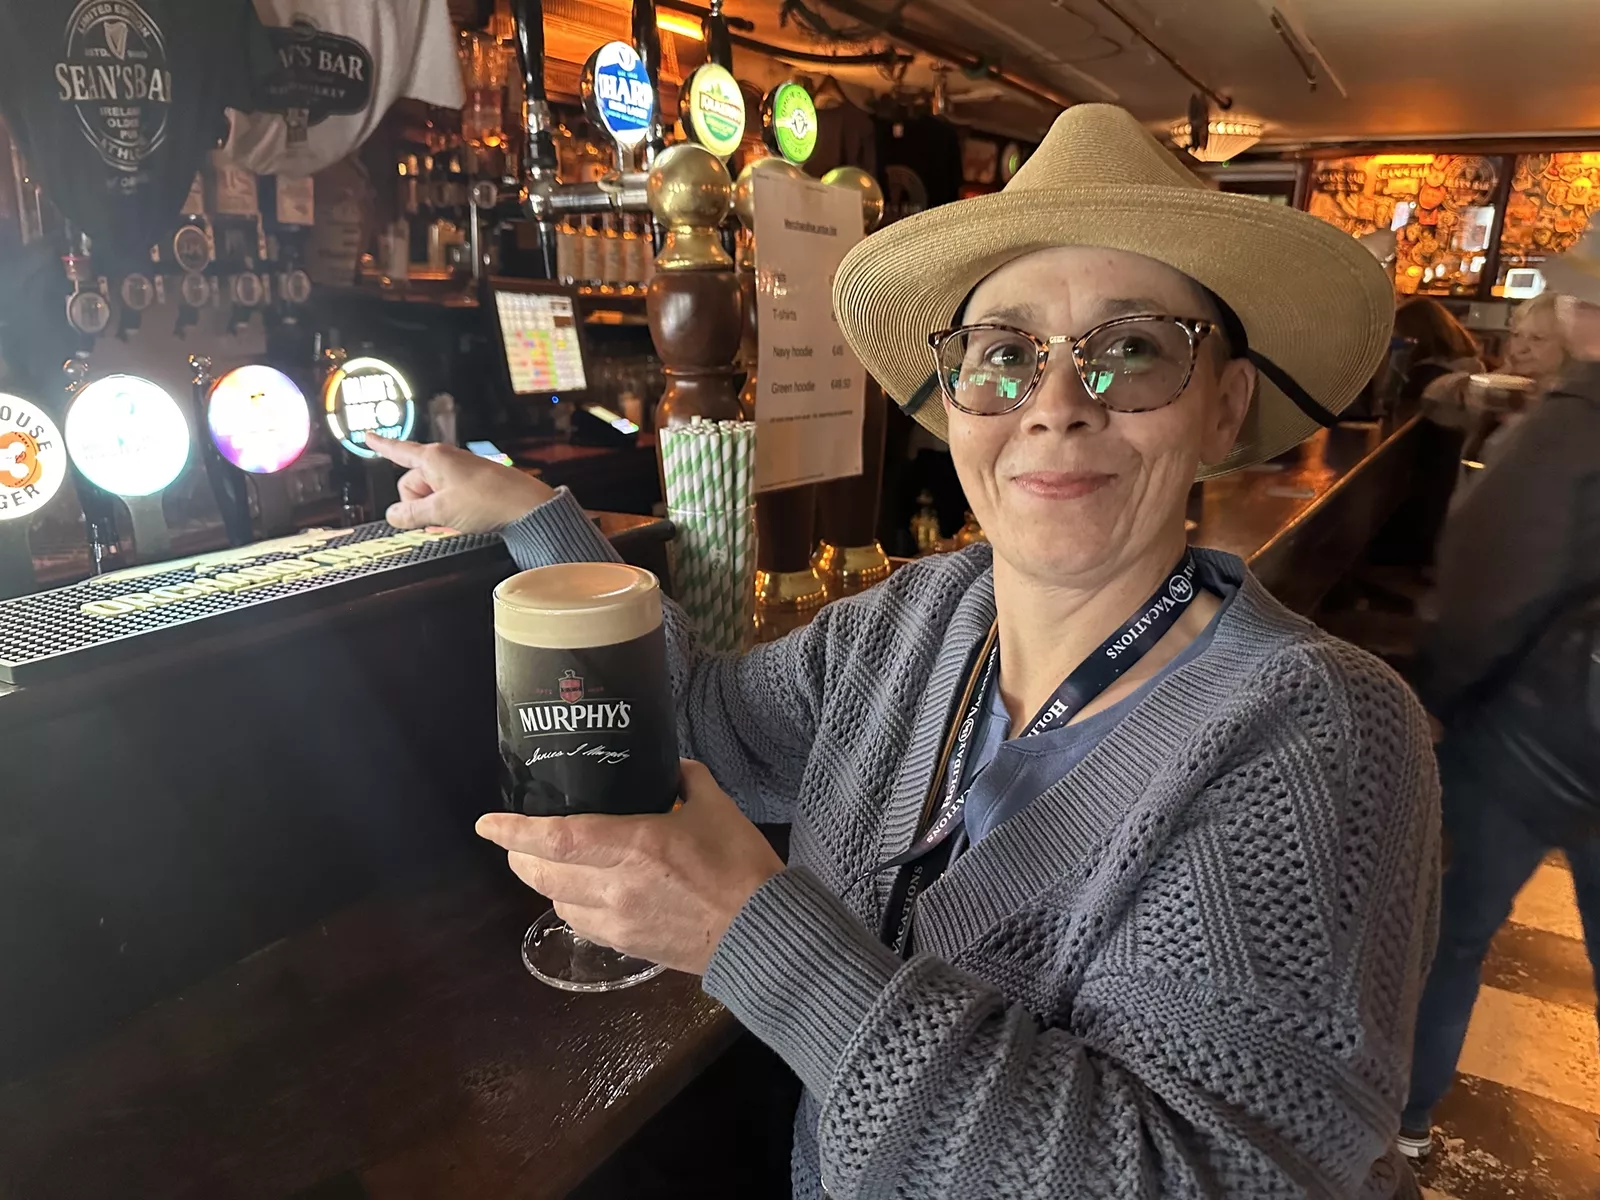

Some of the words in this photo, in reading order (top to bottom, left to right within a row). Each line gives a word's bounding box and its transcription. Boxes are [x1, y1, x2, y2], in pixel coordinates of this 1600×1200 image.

[318, 49, 365, 82] BAR
[1105, 595, 1176, 660] VACATIONS
[518, 700, 631, 733] MURPHY'S
